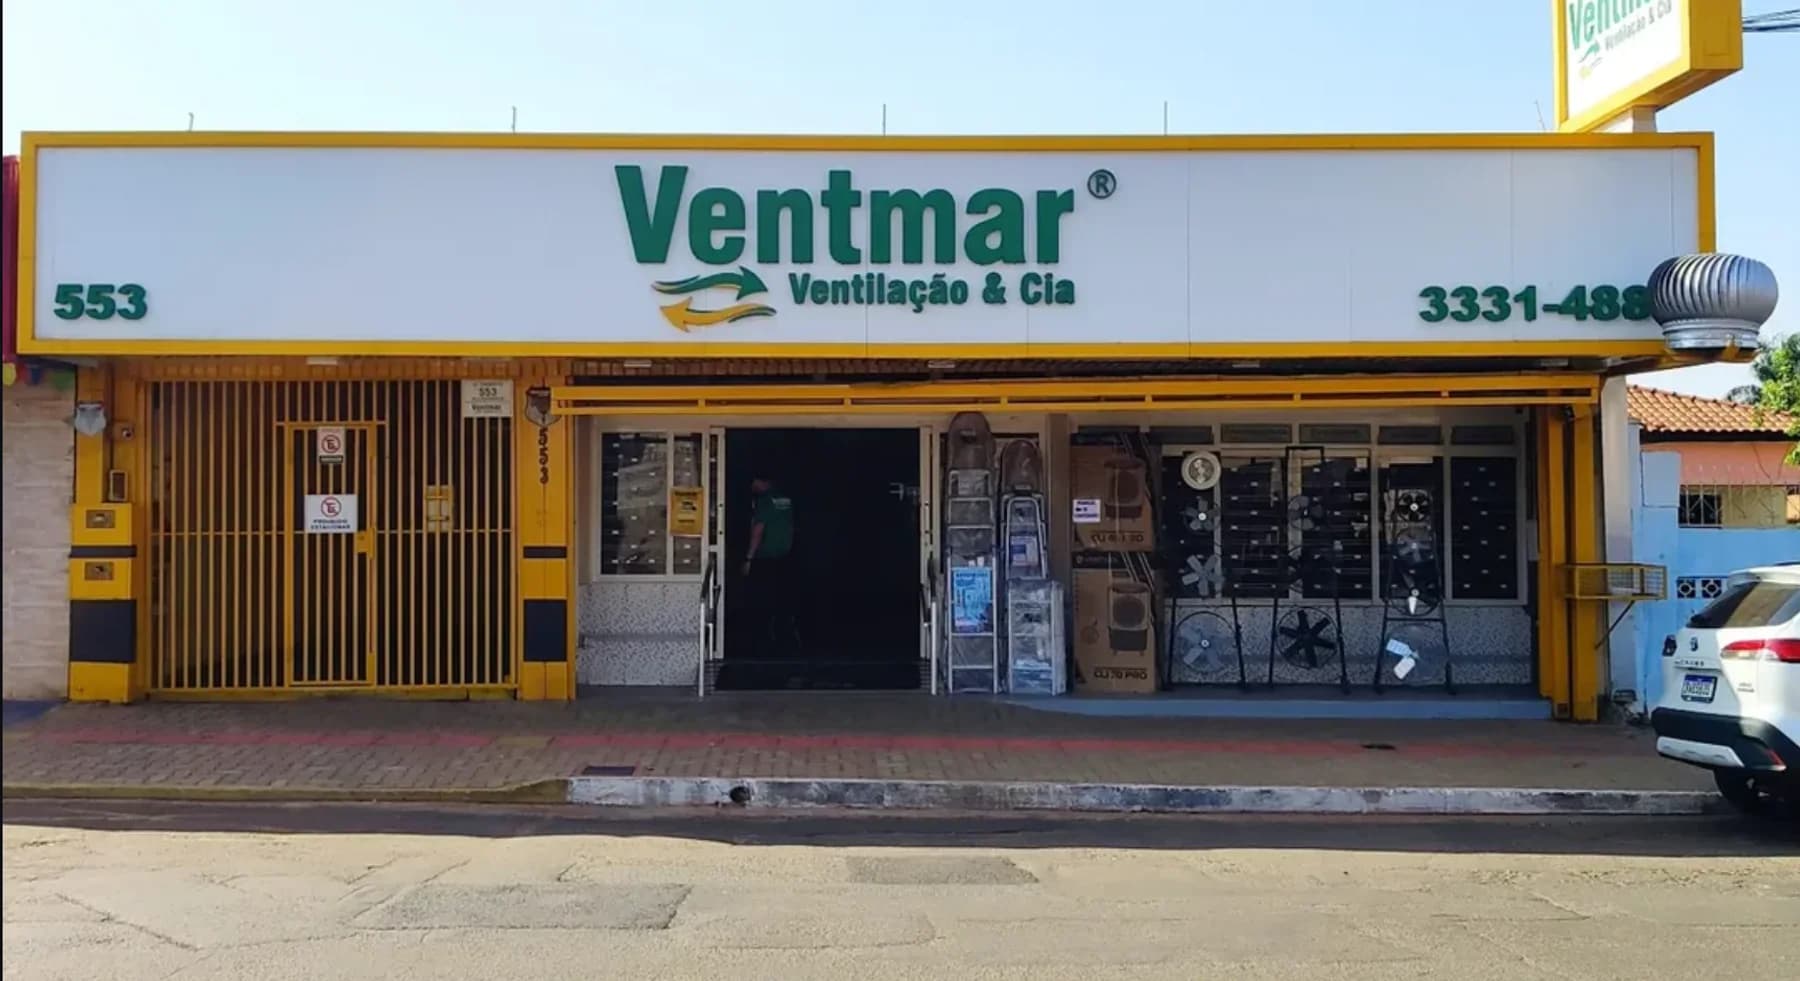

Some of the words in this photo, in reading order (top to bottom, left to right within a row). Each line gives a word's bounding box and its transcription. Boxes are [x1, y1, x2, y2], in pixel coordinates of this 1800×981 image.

[615, 165, 1075, 265] Ventmar
[54, 283, 148, 320] 553
[789, 272, 968, 313] Ventilação
[982, 272, 1006, 305] &
[1020, 272, 1075, 305] Cia
[479, 387, 497, 397] 553
